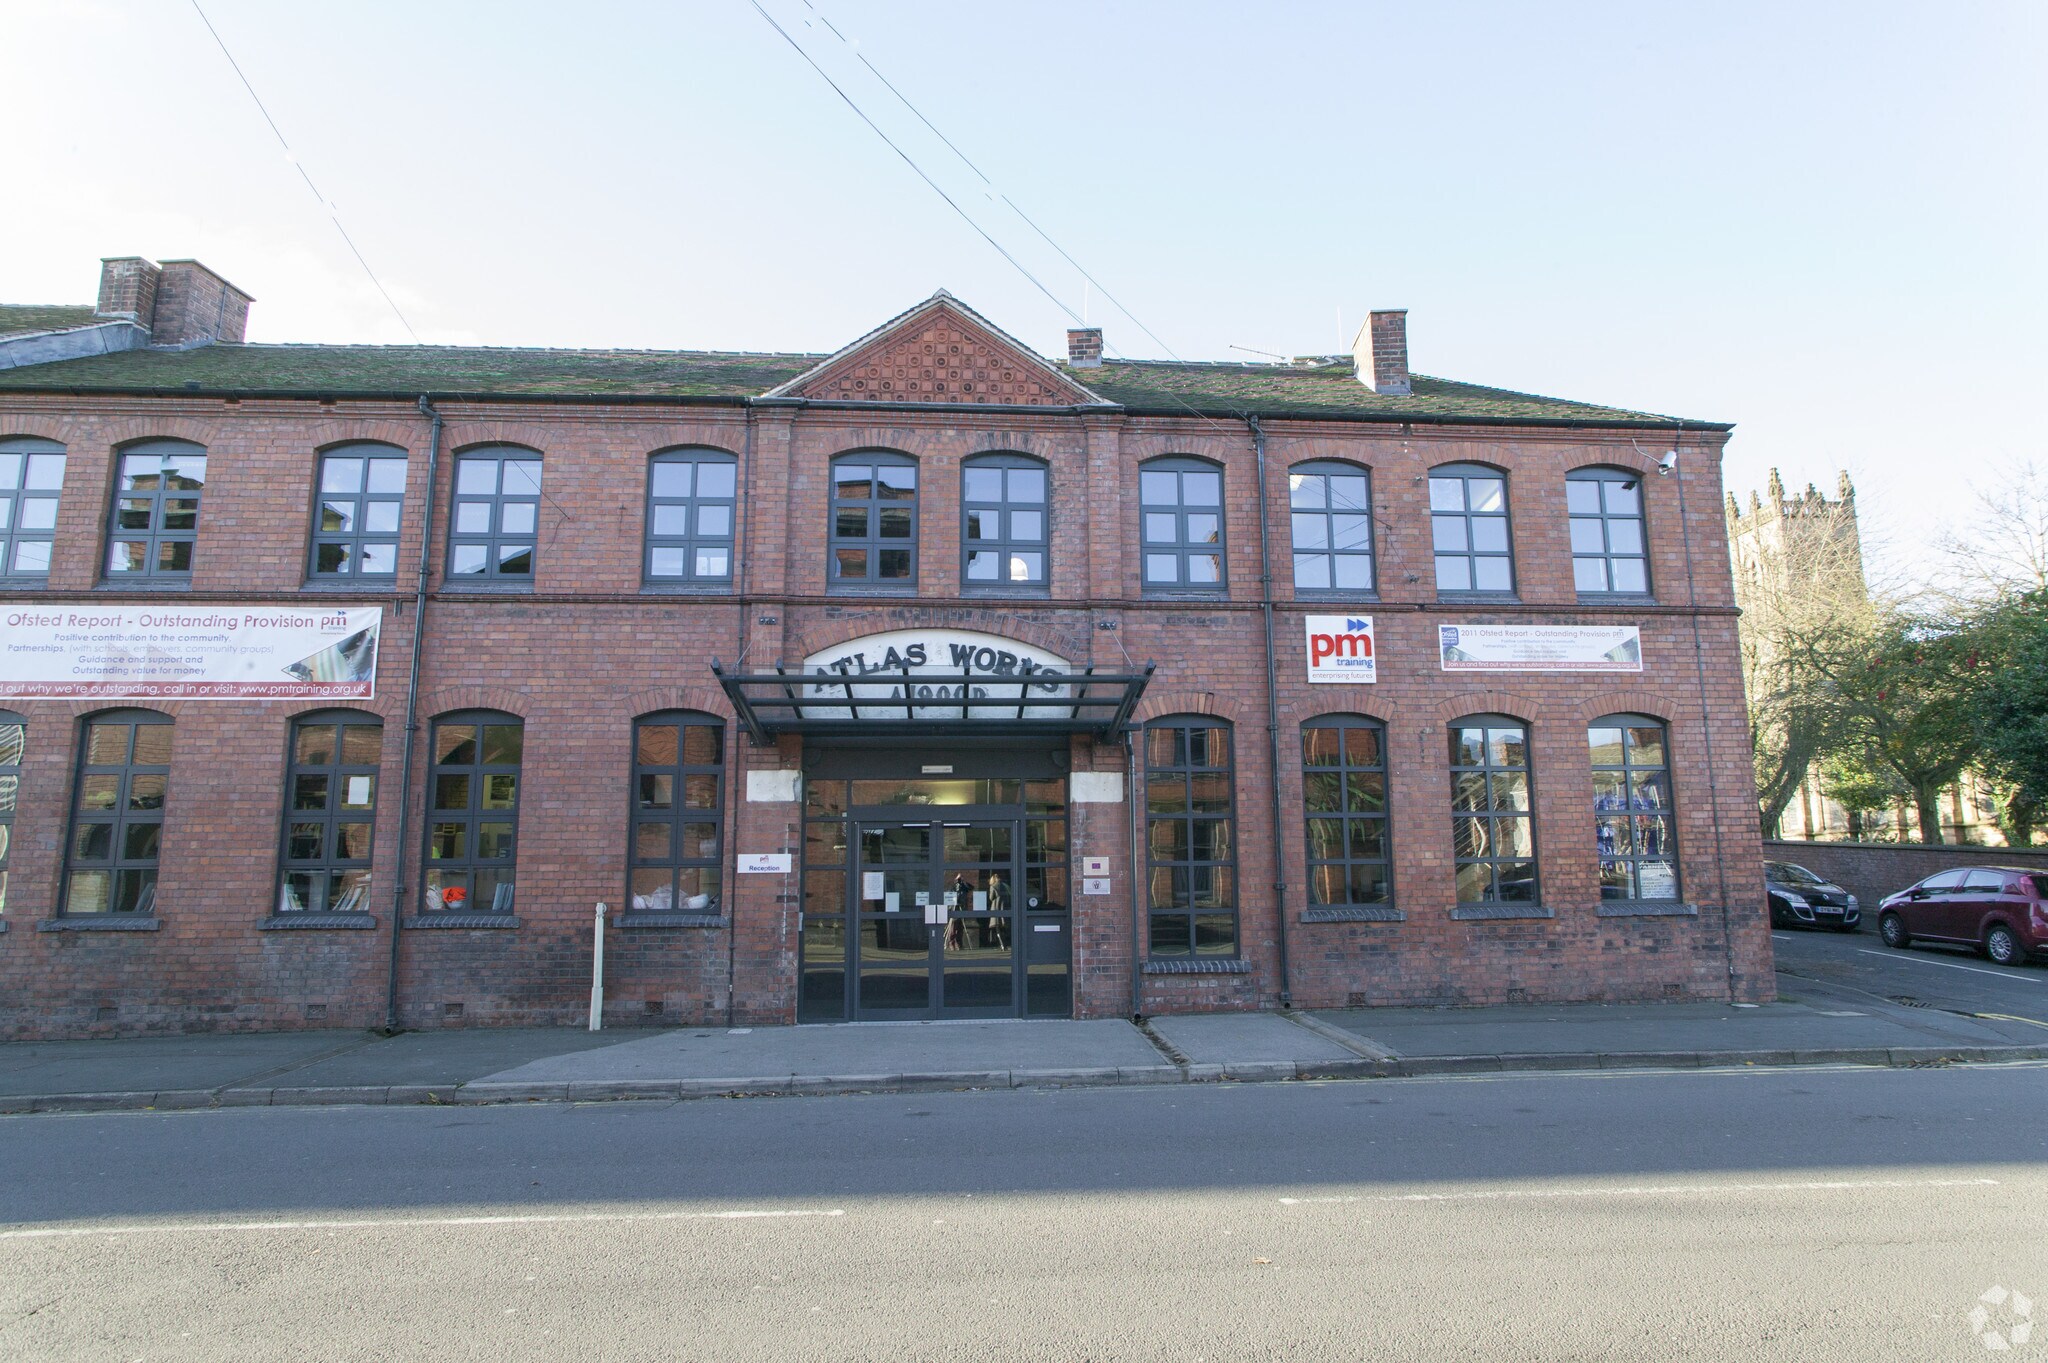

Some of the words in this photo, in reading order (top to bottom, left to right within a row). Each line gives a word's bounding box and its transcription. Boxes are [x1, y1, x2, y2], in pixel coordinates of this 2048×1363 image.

[7, 613, 62, 627] Ofsted
[67, 614, 122, 629] Report
[139, 614, 238, 630] Outstanding
[244, 615, 314, 628] Provision
[321, 616, 347, 630] pm
[54, 634, 89, 642] Positive
[92, 634, 146, 642] contribution
[150, 634, 157, 642] to
[161, 634, 175, 642] the
[178, 634, 232, 643] community.
[1505, 630, 1528, 638] Report
[69, 644, 91, 654] (with
[186, 645, 238, 654] community
[240, 645, 274, 655] groups)
[1311, 633, 1372, 667] pm
[78, 655, 125, 663] Guidance
[128, 655, 146, 663] and
[148, 656, 182, 664] support
[1337, 657, 1373, 669] training
[73, 666, 129, 675] Outstanding
[814, 643, 927, 693] ATLAS
[6, 684, 25, 693] out
[28, 684, 52, 695] why
[55, 684, 88, 693] we're
[90, 684, 160, 695] outstanding,
[164, 684, 184, 694] call
[186, 684, 196, 693] in
[199, 686, 211, 694] or
[214, 684, 237, 694] visit:
[239, 684, 366, 696] www.pmtraining.org.uk
